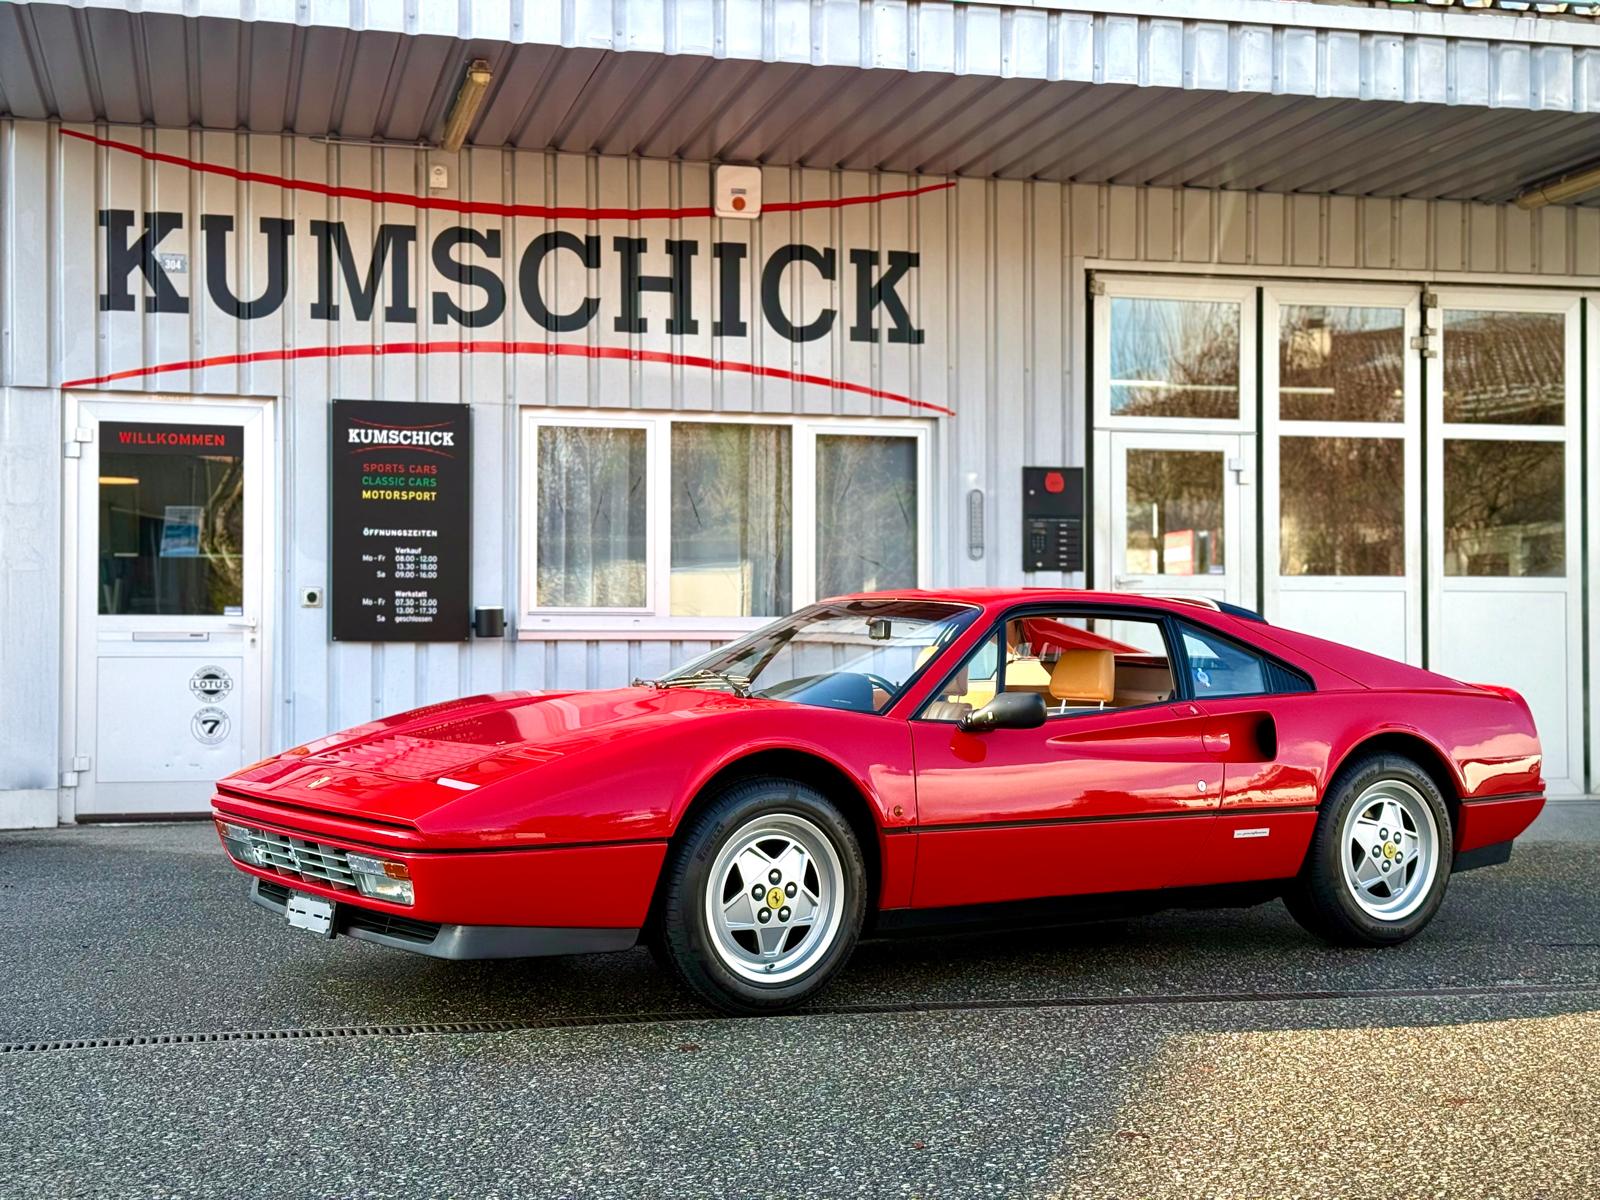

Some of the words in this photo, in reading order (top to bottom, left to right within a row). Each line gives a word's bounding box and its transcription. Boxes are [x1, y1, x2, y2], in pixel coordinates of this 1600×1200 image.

[165, 259, 181, 270] 304
[99, 208, 925, 345] KUMSCHICK
[119, 431, 225, 446] WILLKOMMEN
[348, 428, 455, 446] KUMSCHICK
[363, 463, 405, 473] SPORTS
[409, 464, 438, 474] CARS
[362, 476, 405, 486] CLASSIC
[408, 477, 437, 487] CARS
[362, 490, 437, 501] MOTORSPORT
[363, 527, 438, 537] ÖFFNUNGSZEITEN
[395, 616, 433, 624] geschlossen
[193, 680, 230, 689] LOTUS
[202, 719, 220, 734] 7
